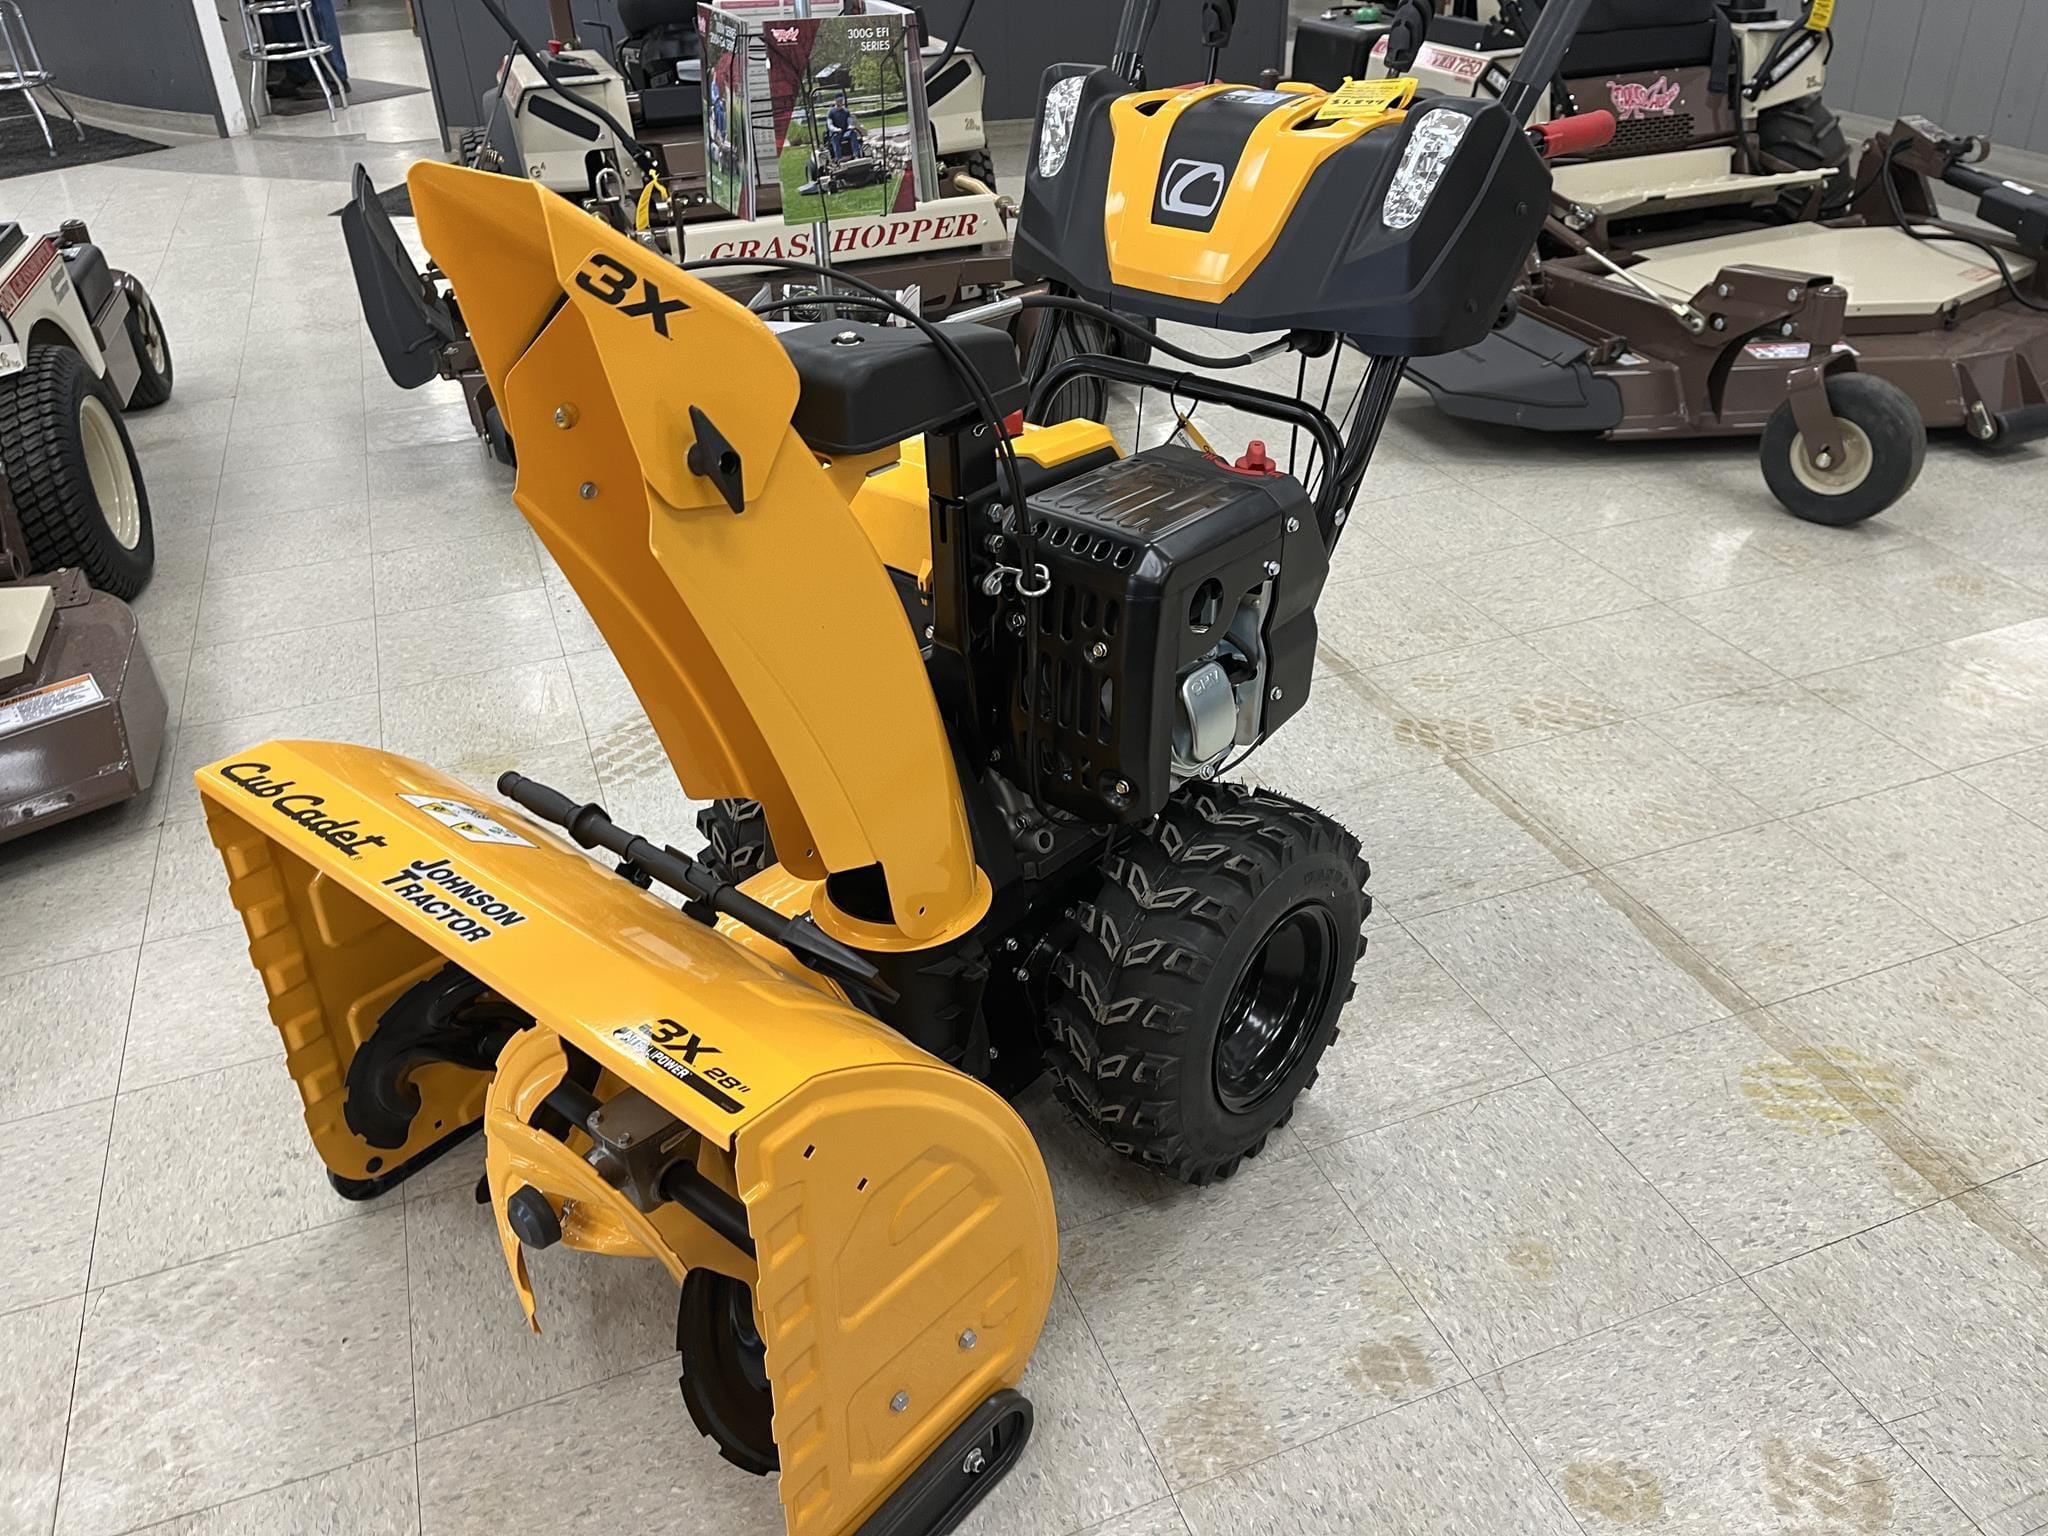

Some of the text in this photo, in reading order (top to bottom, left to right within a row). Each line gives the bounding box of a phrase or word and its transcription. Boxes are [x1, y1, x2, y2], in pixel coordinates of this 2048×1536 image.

[847, 27, 890, 40] 300G EFI
[860, 40, 891, 52] SERIES
[709, 213, 979, 259] GRASHOPPER
[575, 253, 692, 339] 3X
[220, 763, 296, 798] Cub
[272, 795, 388, 857] Cadet
[381, 868, 492, 943] TRACTOR
[410, 859, 527, 927] JOHNSON
[650, 1018, 723, 1066] 3X
[702, 1067, 752, 1093] 28"
